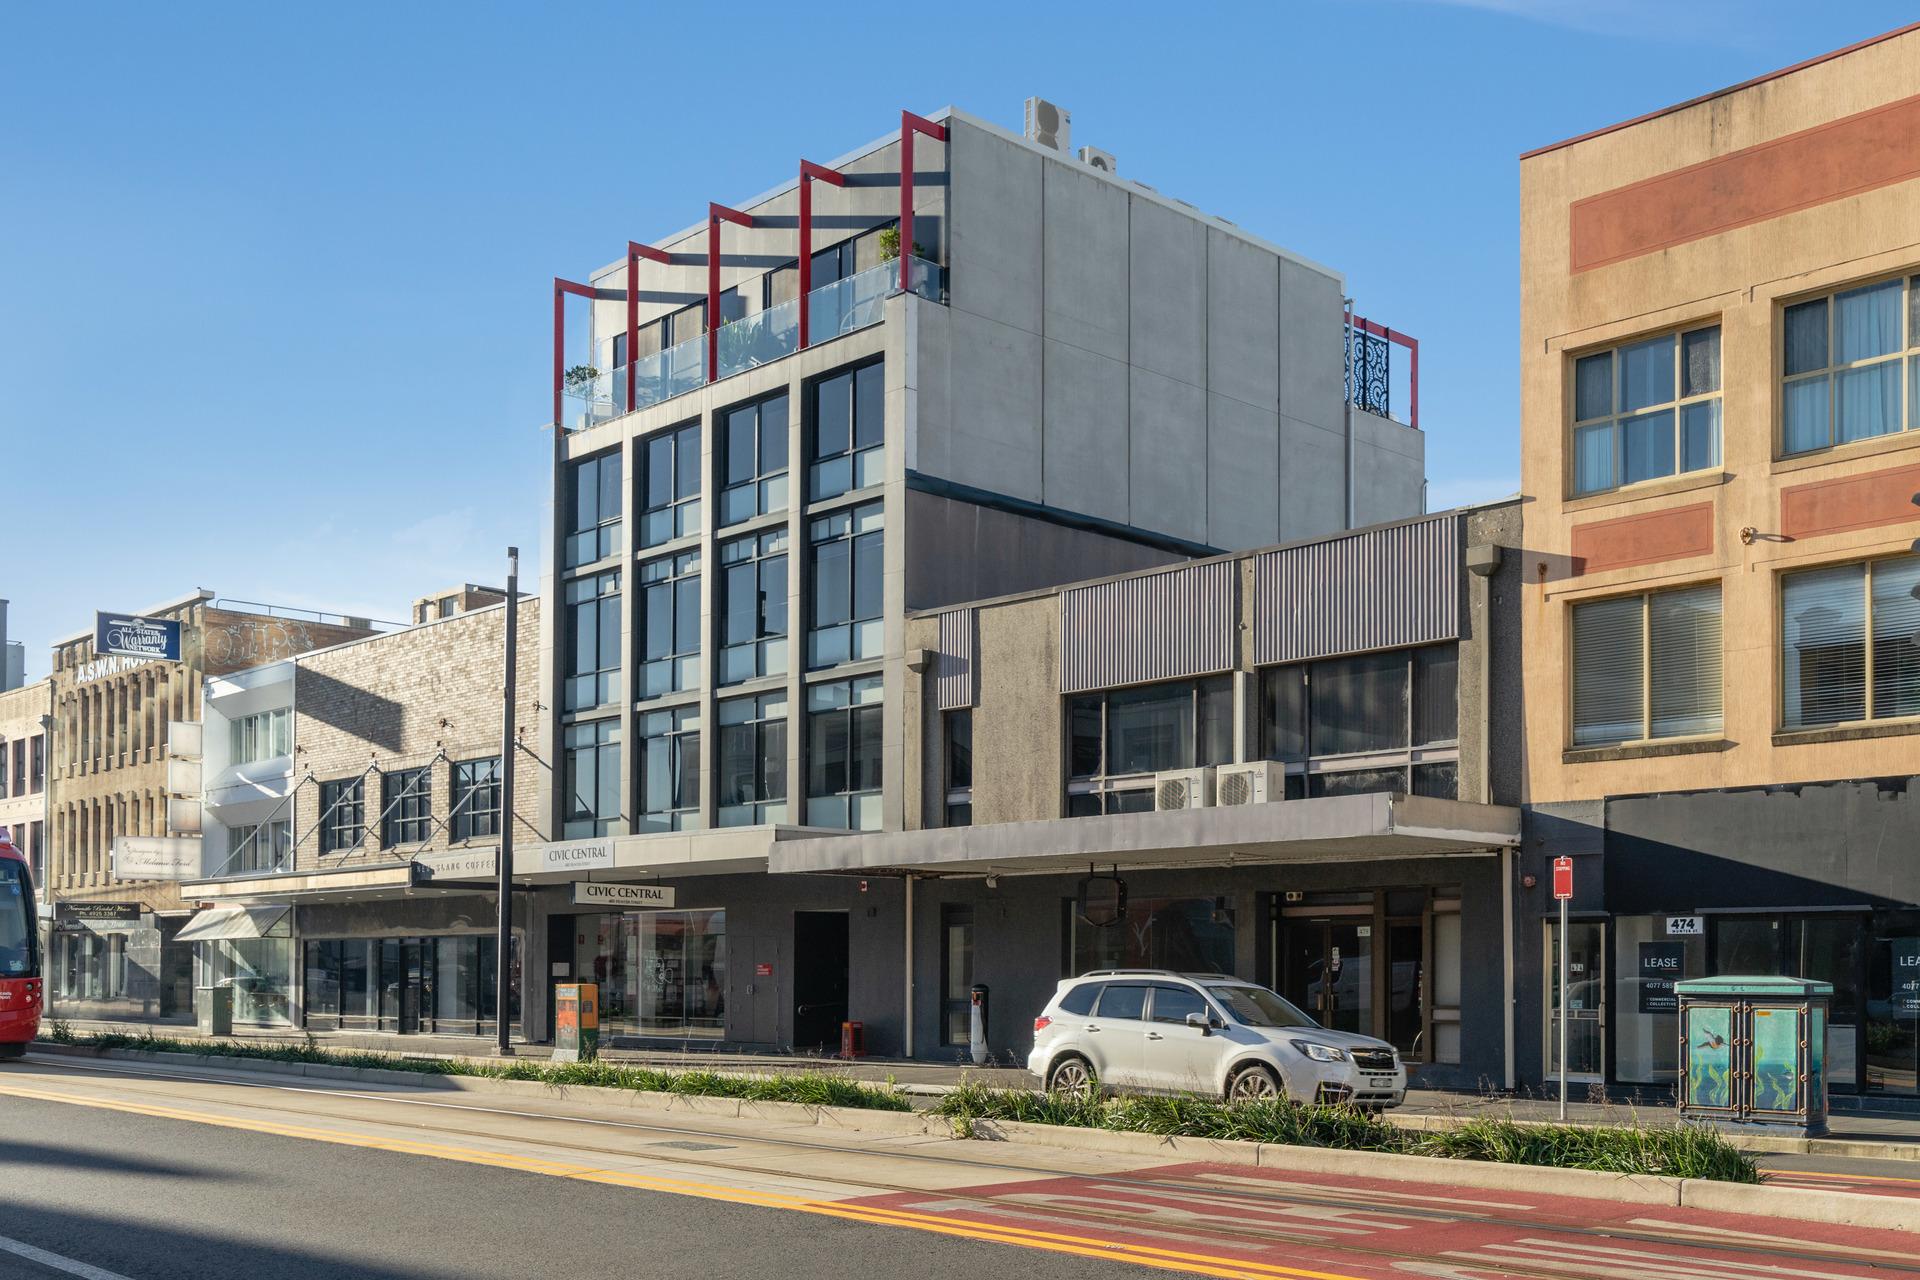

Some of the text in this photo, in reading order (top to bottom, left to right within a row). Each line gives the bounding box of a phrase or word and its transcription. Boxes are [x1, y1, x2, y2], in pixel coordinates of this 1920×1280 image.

[107, 629, 167, 650] Warranty
[129, 644, 160, 653] NETWORK
[77, 656, 119, 684] A.S.W.N.
[549, 846, 607, 861] CIVIC CENTRAL
[416, 865, 431, 873] NEW
[465, 859, 495, 870] COFFEE
[587, 886, 663, 899] CIVIC CENTRAL
[1671, 918, 1695, 929] 474
[1644, 957, 1678, 968] LEASE
[901, 1173, 1537, 1250] TRAM
